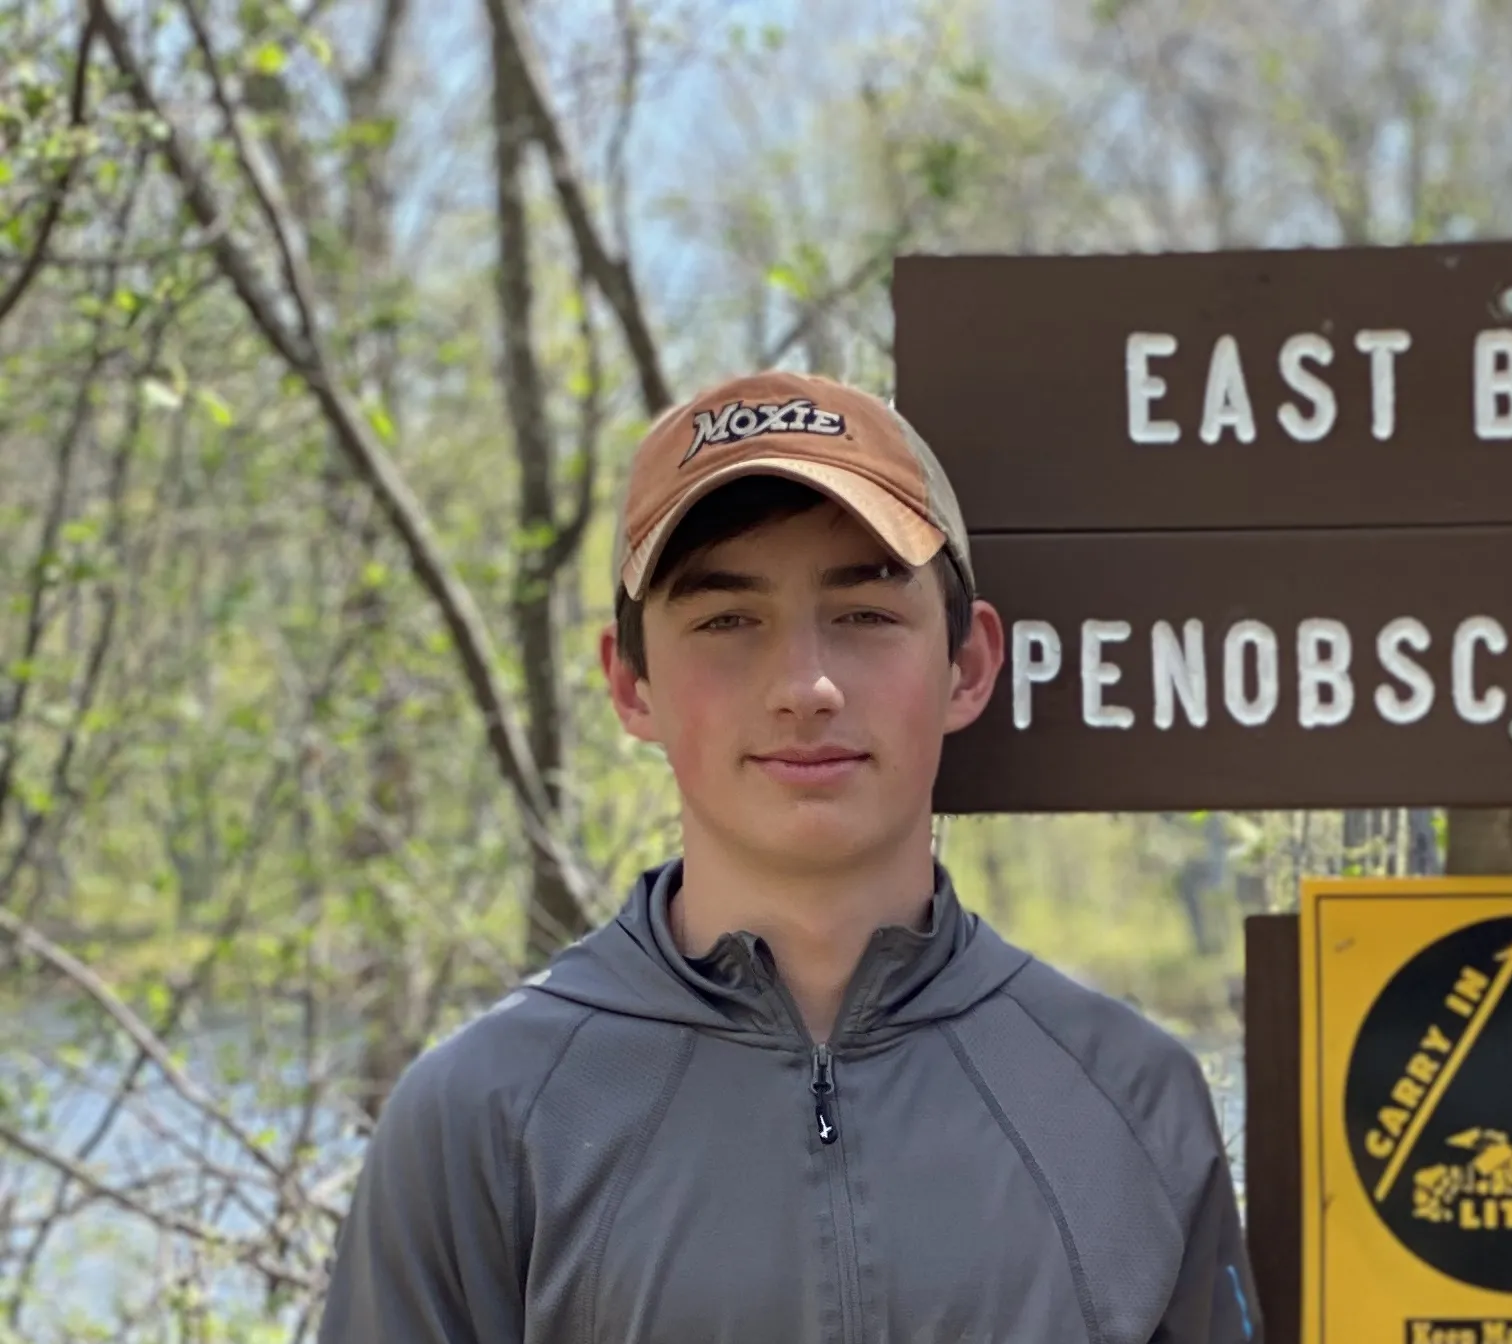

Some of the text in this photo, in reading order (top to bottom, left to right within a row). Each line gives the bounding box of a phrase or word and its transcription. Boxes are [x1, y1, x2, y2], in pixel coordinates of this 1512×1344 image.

[678, 397, 846, 468] MOXIE
[1125, 330, 1412, 445] EAST
[1363, 965, 1490, 1159] CARRY IN
